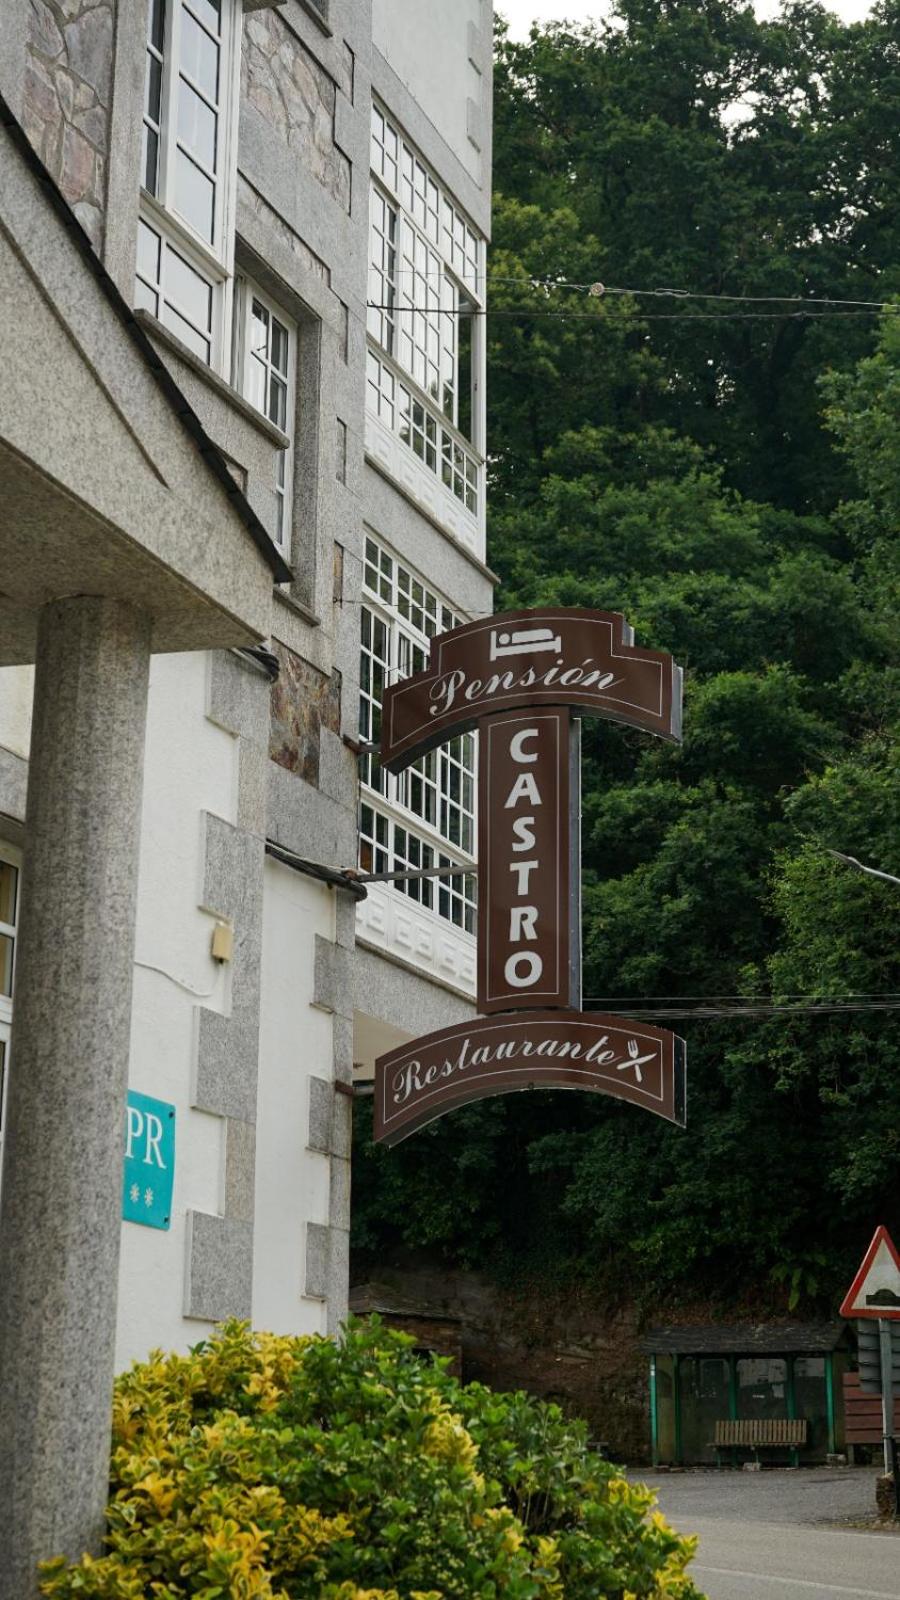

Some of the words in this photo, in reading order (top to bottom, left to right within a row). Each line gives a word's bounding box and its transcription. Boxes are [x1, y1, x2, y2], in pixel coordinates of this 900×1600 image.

[429, 659, 625, 716] Pensión
[504, 728, 543, 988] CASTRO
[392, 1036, 623, 1103] Restaurante
